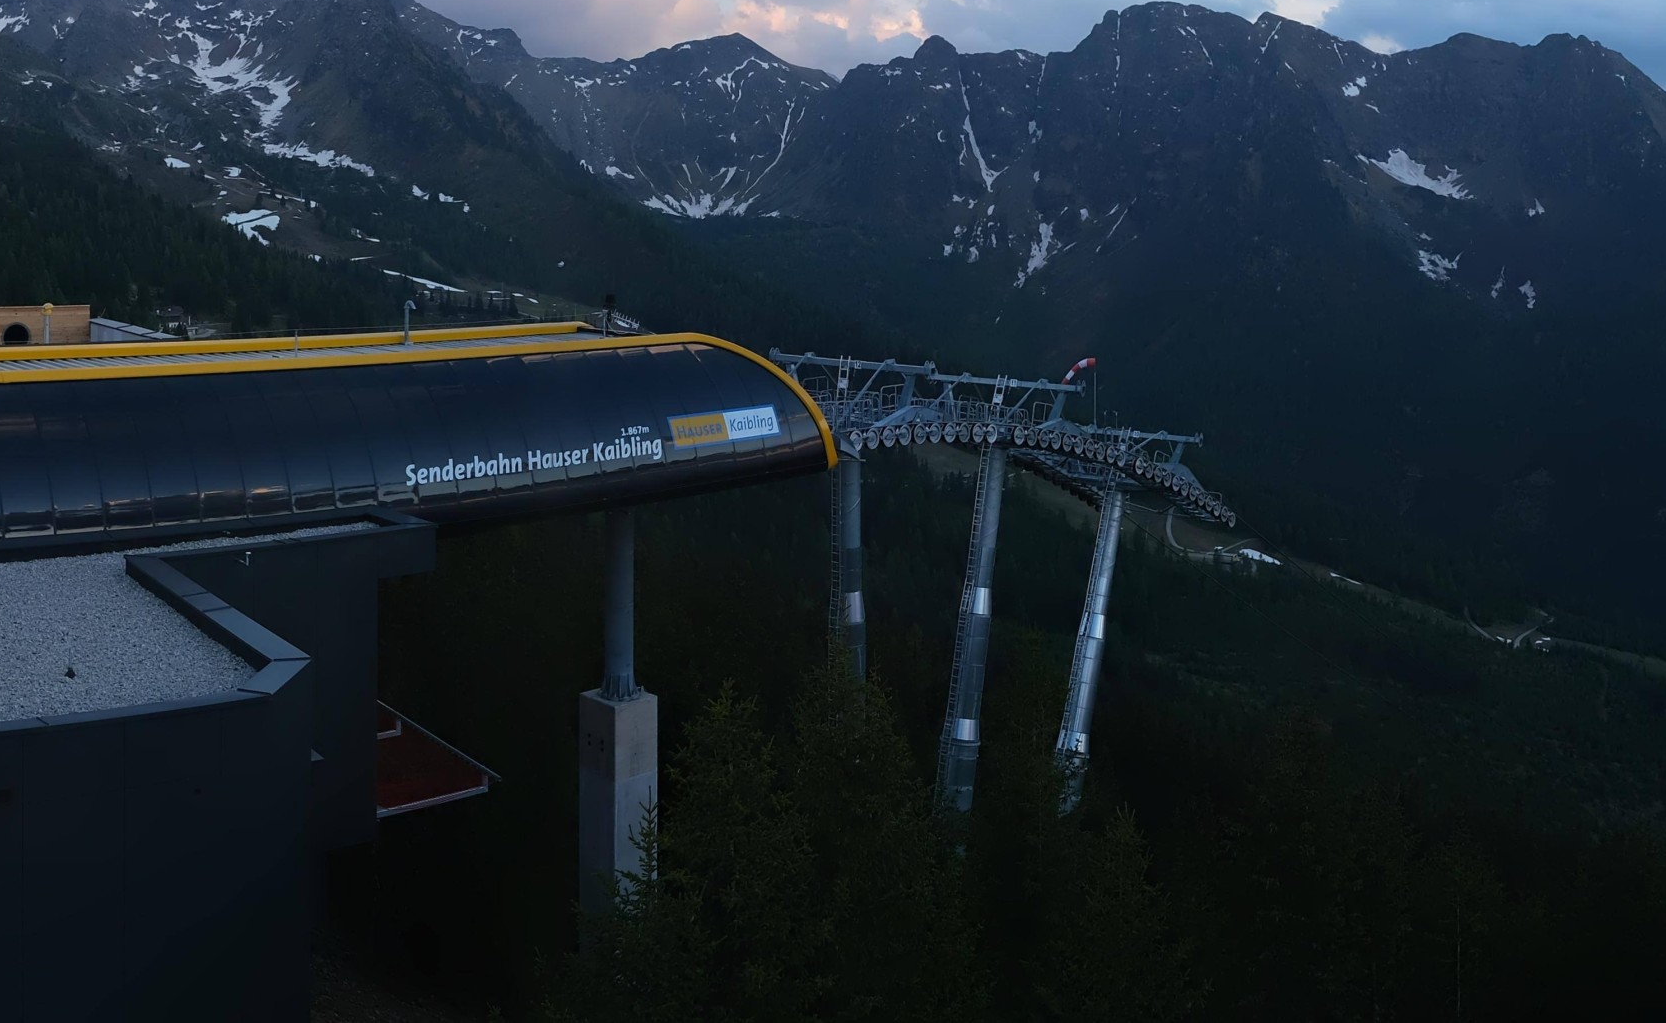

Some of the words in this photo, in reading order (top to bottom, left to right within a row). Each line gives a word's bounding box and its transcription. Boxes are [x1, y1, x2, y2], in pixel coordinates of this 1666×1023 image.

[621, 426, 650, 437] 1.867m
[676, 423, 723, 439] HAUSER
[729, 415, 774, 432] Kaibling
[406, 452, 523, 486] Senderbahn
[528, 447, 589, 471] Hauser
[593, 436, 663, 460] Kaibling
